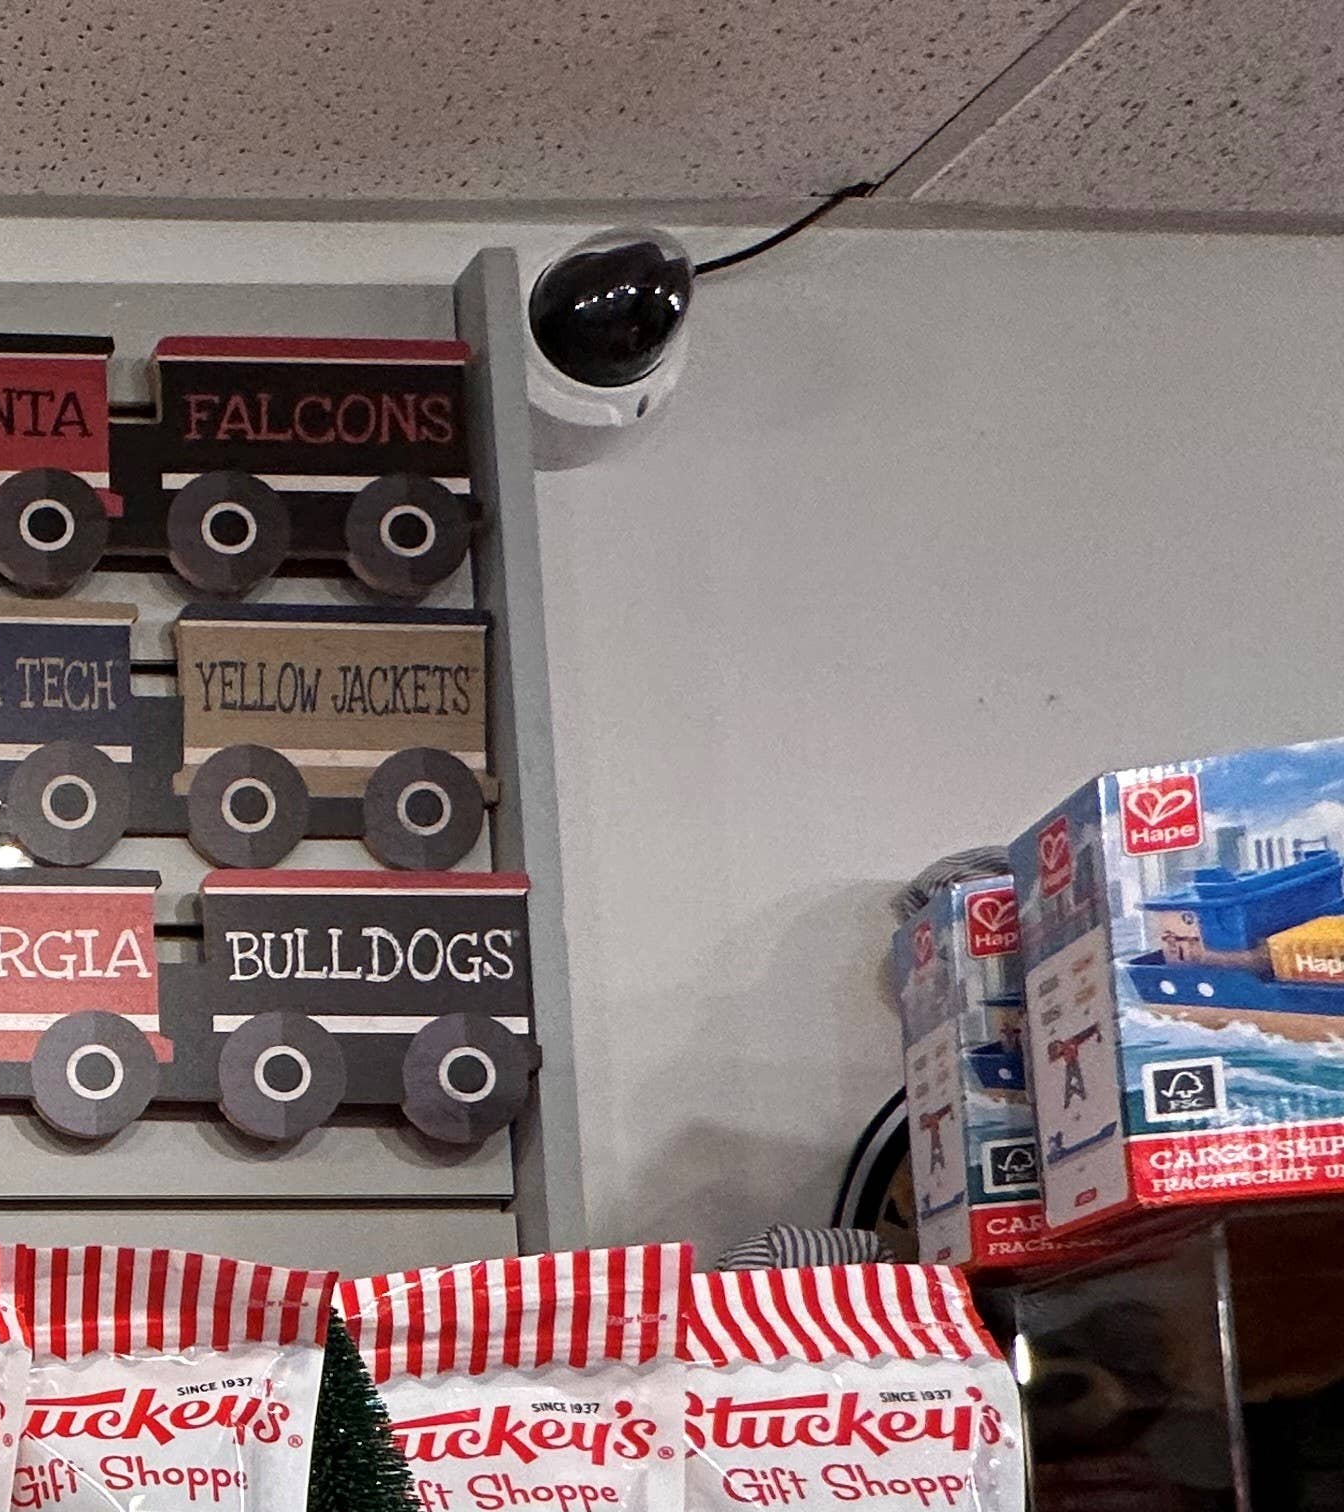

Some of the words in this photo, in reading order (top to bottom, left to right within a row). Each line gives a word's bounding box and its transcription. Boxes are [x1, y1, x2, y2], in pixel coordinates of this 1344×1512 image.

[183, 394, 455, 444] FALCONS
[16, 657, 115, 711] TECH
[196, 661, 320, 714] YELLOW
[331, 663, 472, 716] JACKETS
[1131, 823, 1195, 846] Hape
[225, 928, 514, 984] BULLDOGS
[1149, 1143, 1269, 1170] CARGO
[1277, 1136, 1344, 1160] SHIP
[1152, 1166, 1317, 1193] FRACHTSCHIFF
